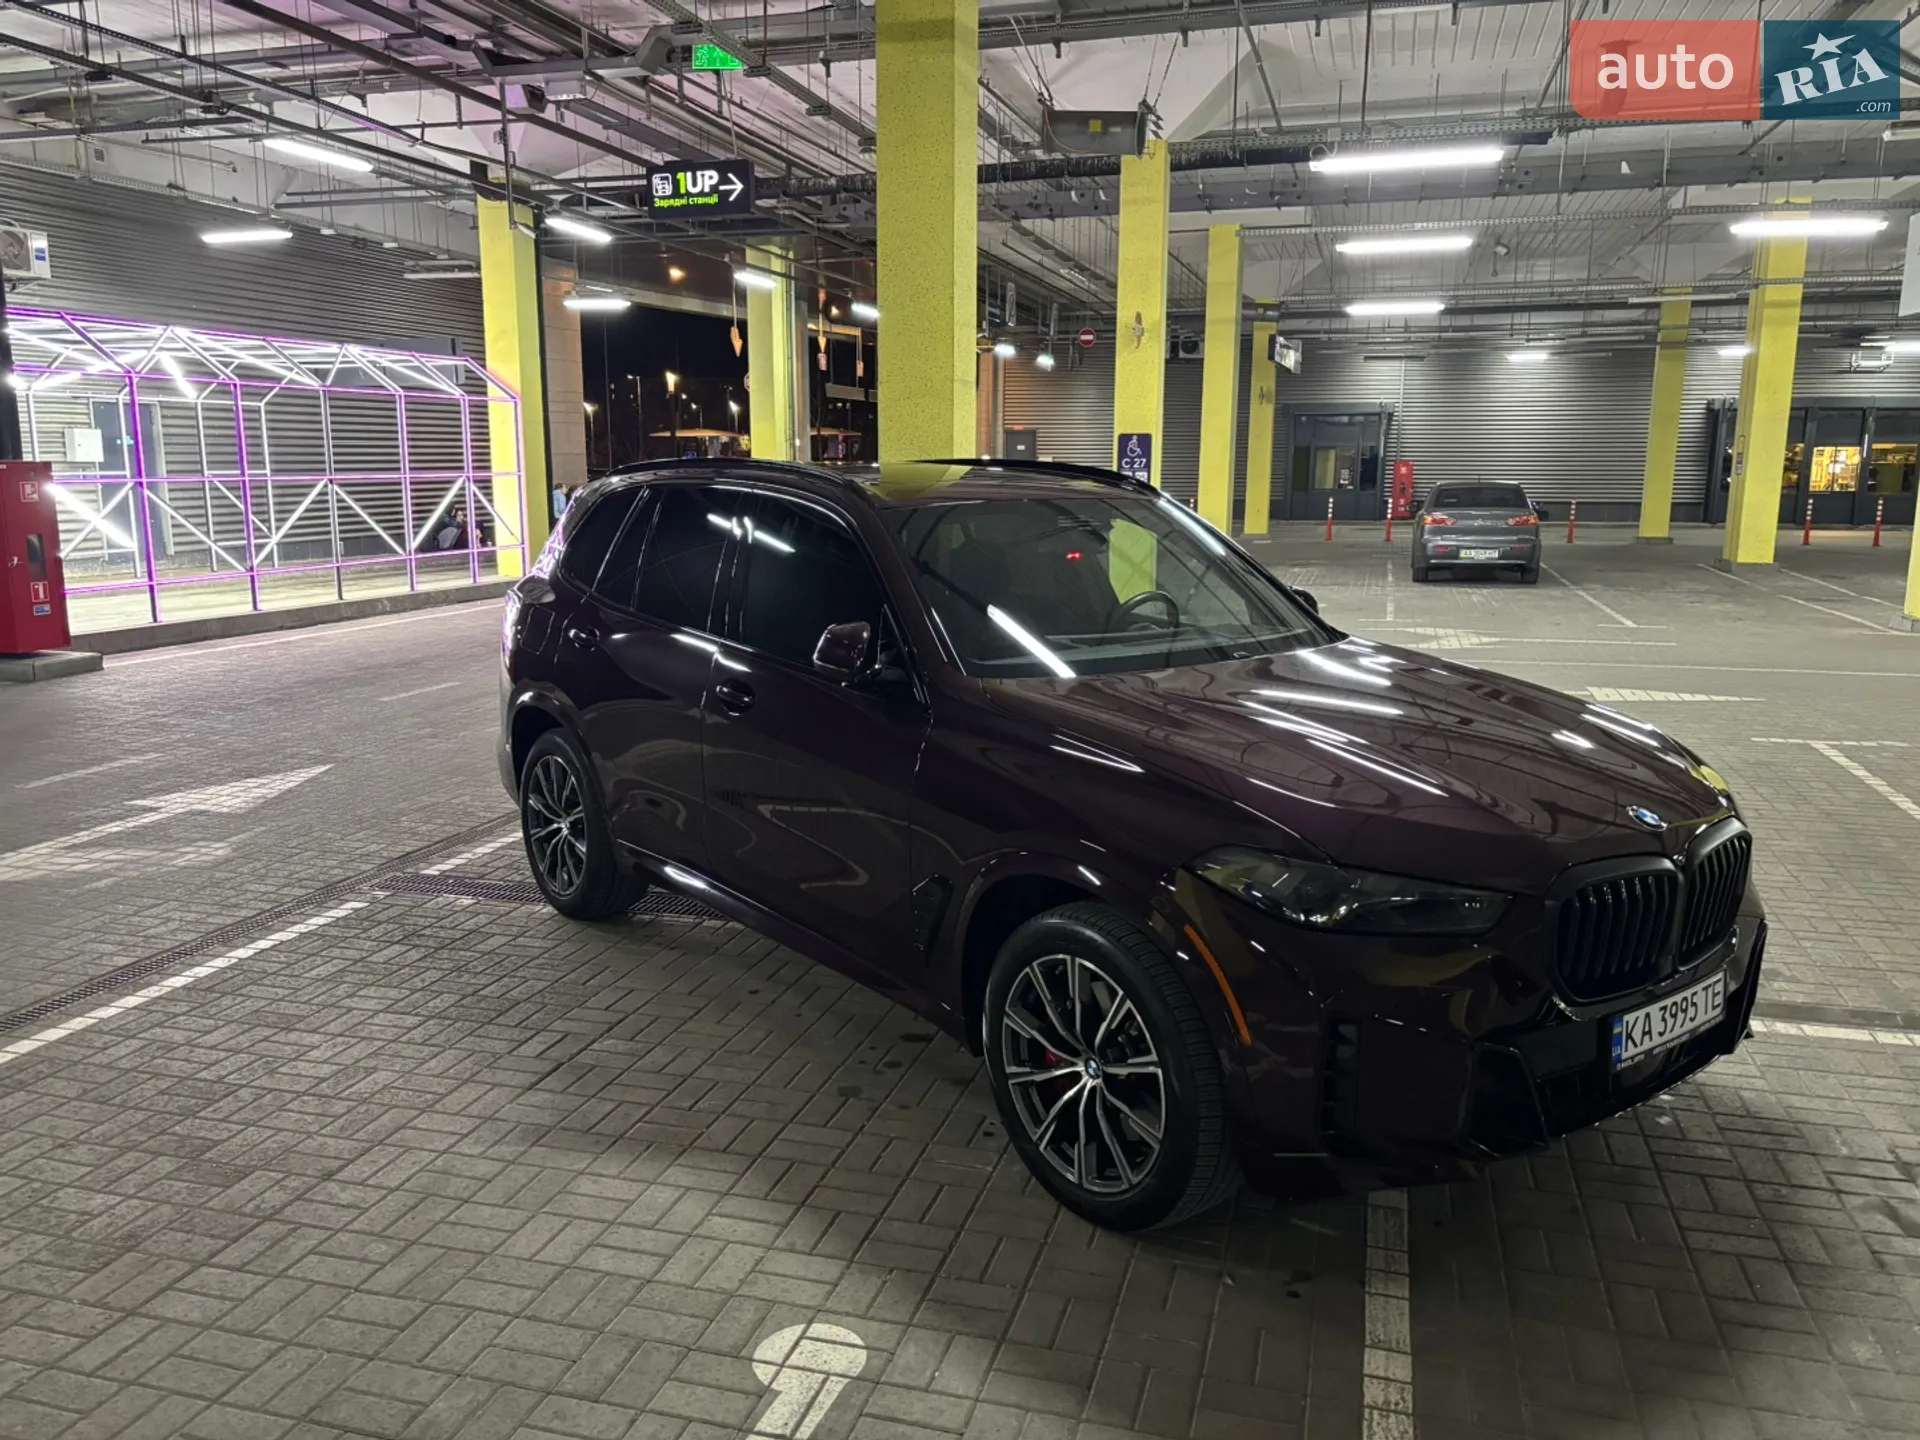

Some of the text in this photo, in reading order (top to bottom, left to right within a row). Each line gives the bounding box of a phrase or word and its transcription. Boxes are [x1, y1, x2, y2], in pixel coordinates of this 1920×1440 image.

[676, 170, 719, 194] 1UP
[653, 194, 718, 207] Зарядні станції
[1121, 458, 1147, 468] C 27
[1624, 1012, 1653, 1052] KA
[1657, 991, 1698, 1037] 3995
[1702, 977, 1722, 1015] TE
[1612, 1044, 1621, 1057] UA
